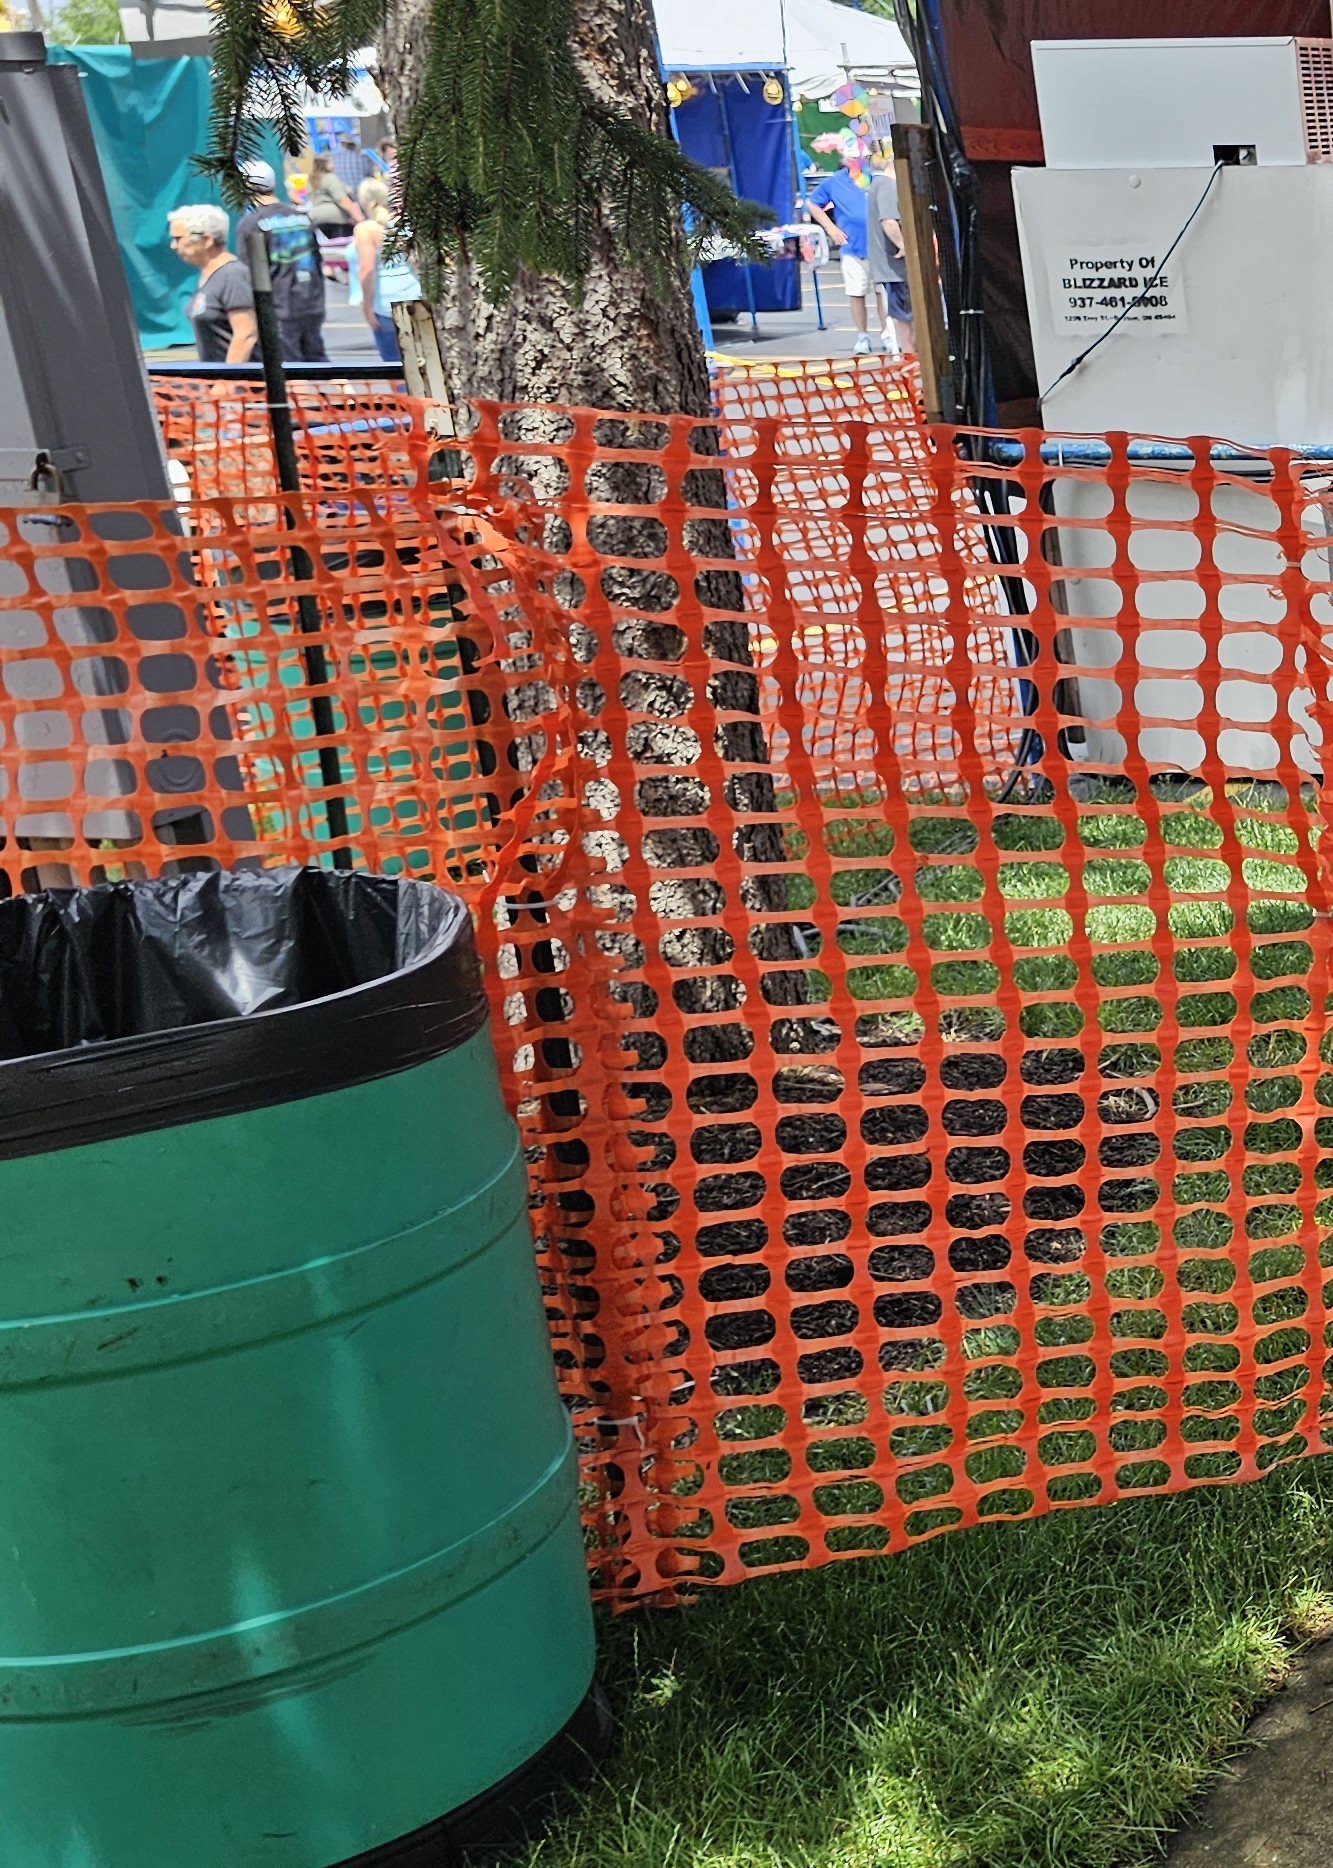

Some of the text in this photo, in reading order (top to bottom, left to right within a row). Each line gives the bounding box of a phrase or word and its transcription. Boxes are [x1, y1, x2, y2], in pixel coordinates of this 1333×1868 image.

[1069, 256, 1155, 272] Property Of
[1062, 276, 1169, 289] BLIZZARD ICE
